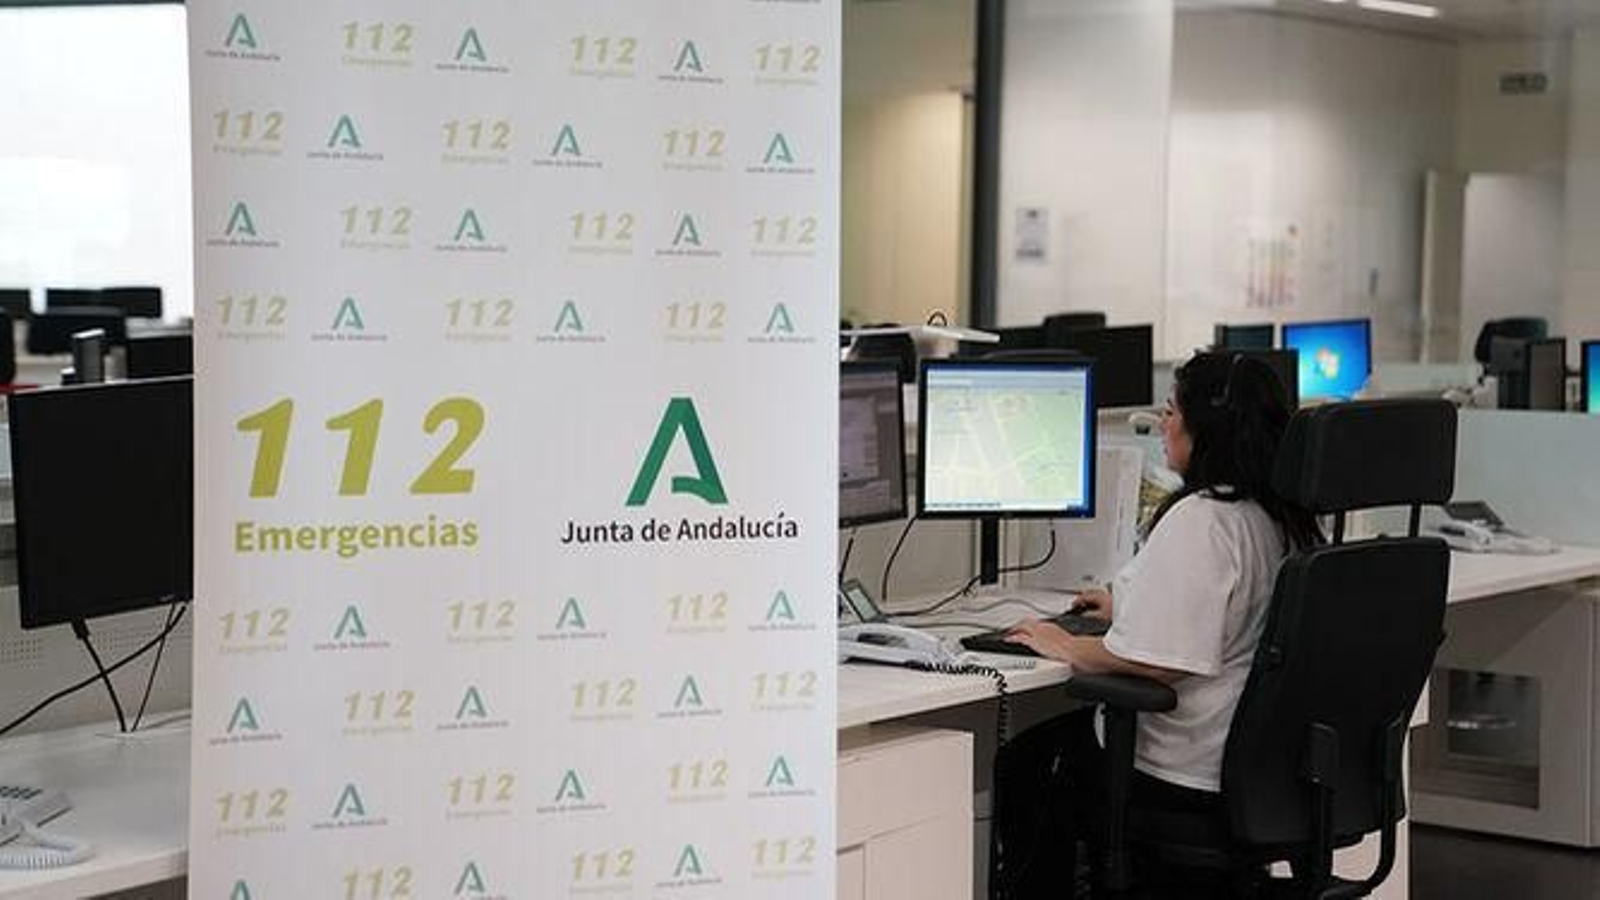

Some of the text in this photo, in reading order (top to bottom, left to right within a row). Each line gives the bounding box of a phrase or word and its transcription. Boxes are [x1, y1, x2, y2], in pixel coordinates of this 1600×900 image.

[342, 23, 413, 52] 112
[570, 36, 637, 64] 112
[754, 45, 819, 73] 112
[212, 111, 283, 141] 112
[442, 118, 510, 150] 112
[662, 129, 724, 156] 112
[340, 205, 412, 235] 112
[571, 210, 636, 240] 112
[752, 215, 820, 244] 112
[215, 295, 287, 326] 112
[445, 298, 513, 327] 112
[665, 302, 727, 330] 112
[236, 397, 485, 498] 112
[234, 516, 480, 558] Emergencias
[561, 512, 799, 544] Junta de Andalucía
[446, 600, 517, 632] 112
[663, 592, 729, 621] 112
[219, 606, 291, 640] 112
[572, 678, 639, 710] 112
[753, 671, 816, 699] 112
[343, 690, 416, 721] 112
[446, 772, 514, 805] 112
[667, 758, 729, 791] 112
[216, 788, 290, 823] 112
[572, 847, 634, 882] 112
[752, 836, 815, 866] 112
[342, 866, 412, 900] 112
